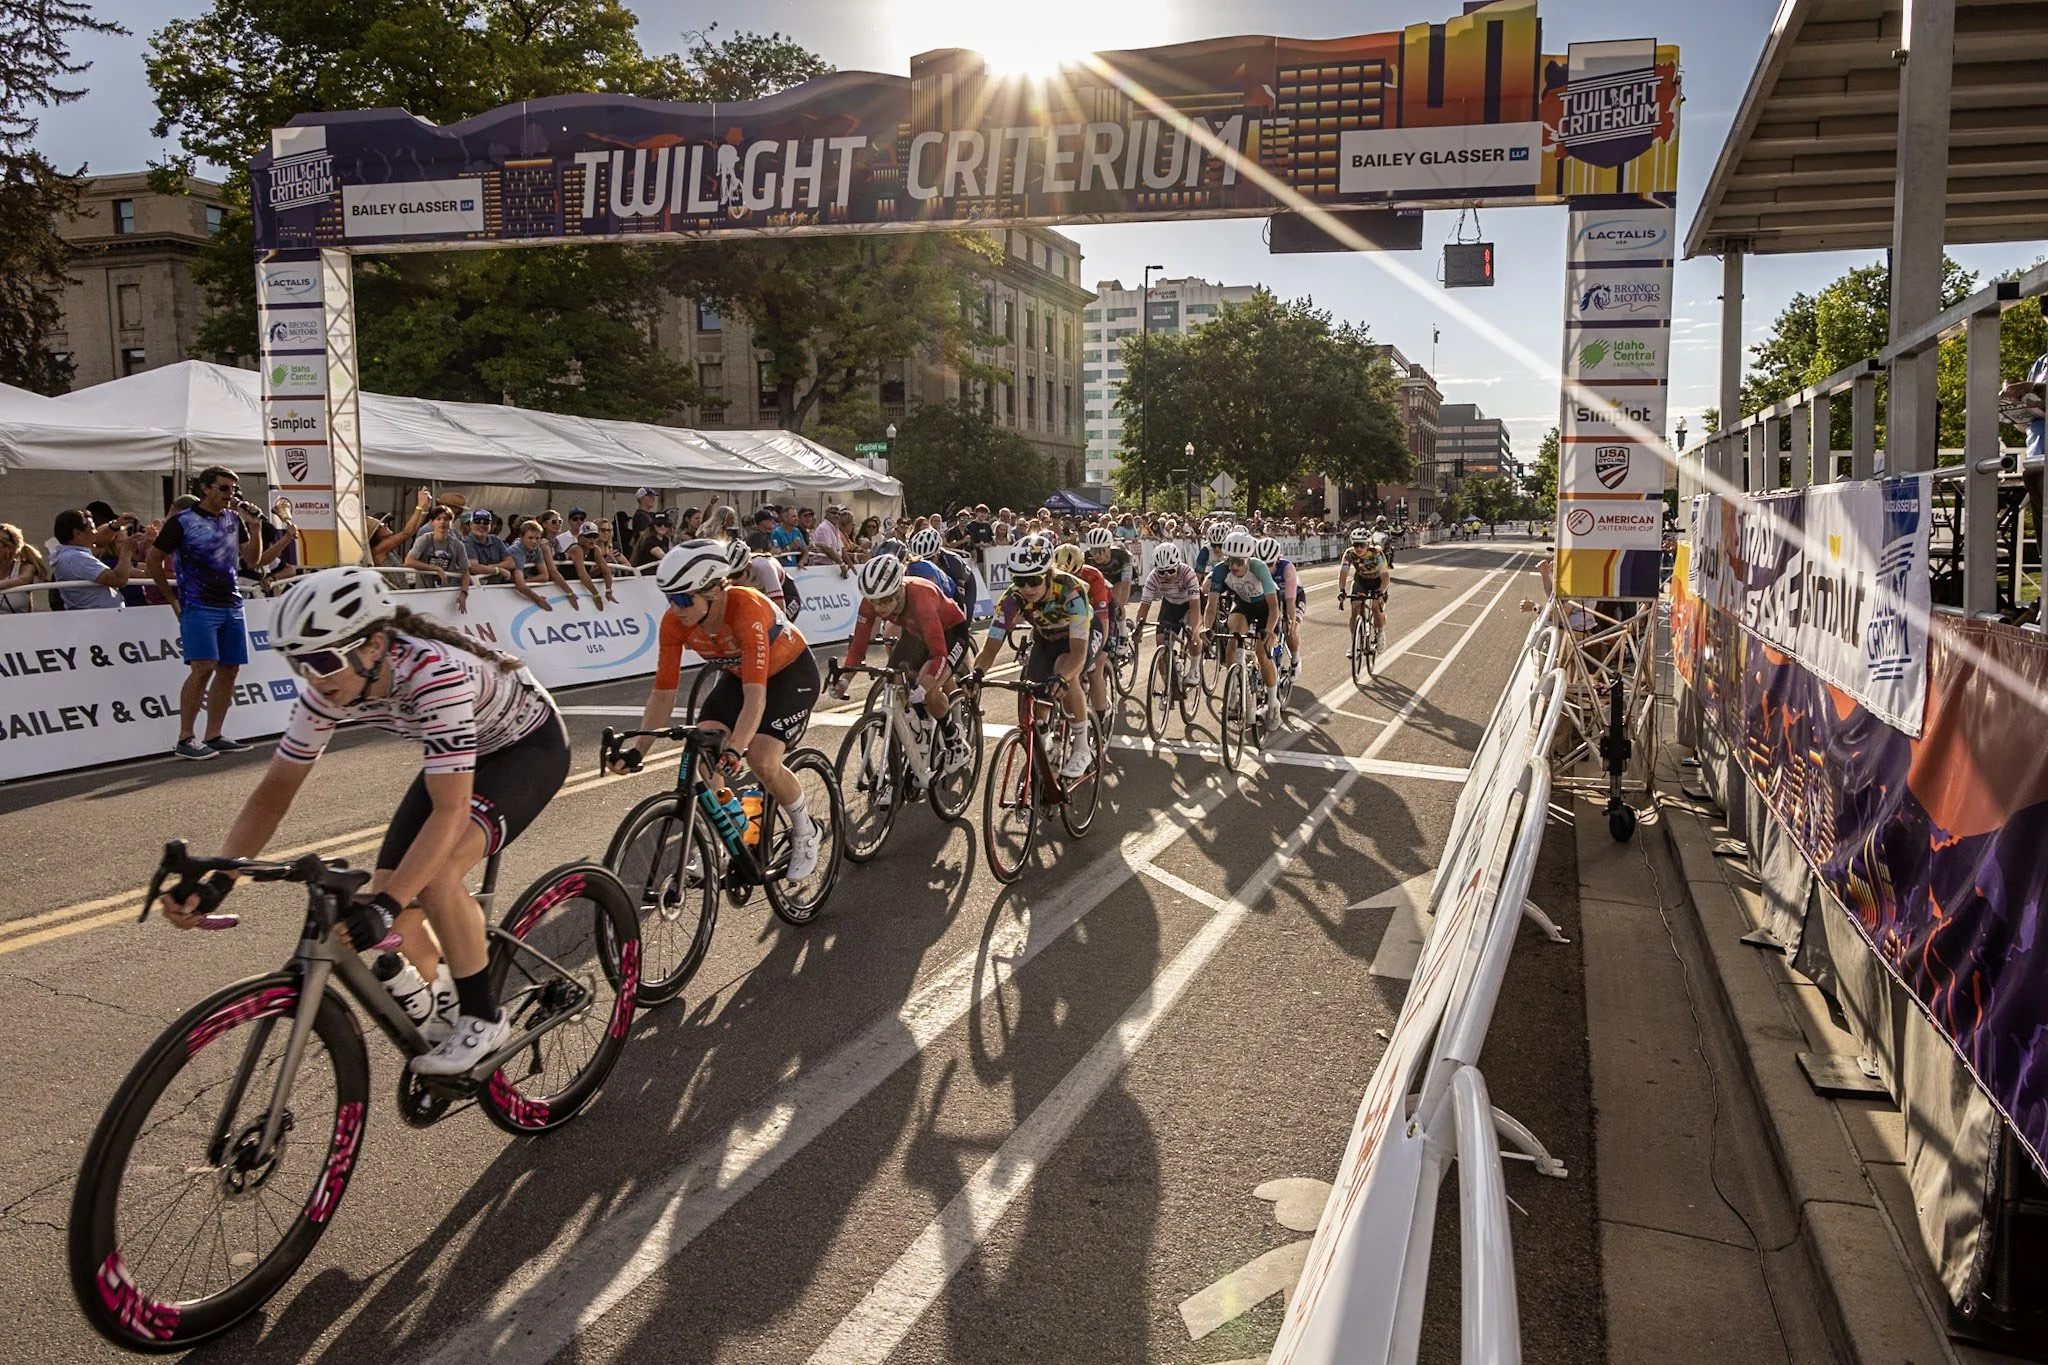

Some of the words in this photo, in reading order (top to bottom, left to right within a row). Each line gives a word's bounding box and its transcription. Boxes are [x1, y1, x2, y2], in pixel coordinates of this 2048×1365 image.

[1558, 102, 1660, 138] CRITERIUM
[906, 114, 1243, 200] CRITERIUM
[1351, 152, 1416, 168] BAILEY
[1419, 148, 1505, 165] GLASSER
[1510, 149, 1528, 159] LLP
[269, 178, 335, 204] CRITERIUM
[352, 203, 396, 217] BAILEY
[399, 200, 458, 214] GLASSER
[461, 201, 474, 210] LLP
[1588, 229, 1656, 240] LACTALIS
[268, 278, 311, 287] LACTALIS
[1614, 284, 1660, 293] BRONCO
[1614, 293, 1660, 303] MOTORS
[289, 320, 317, 328] BRONCO
[1613, 340, 1645, 350] Idaho
[1613, 350, 1656, 361] Central
[291, 373, 318, 381] Central
[1577, 406, 1651, 427] Simplot
[271, 417, 317, 433] Simplot
[1599, 449, 1626, 459] USA
[1597, 514, 1654, 524] AMERICAN
[800, 593, 851, 612] ACTALIS
[528, 617, 640, 645] LACTALIS
[586, 644, 605, 654] USA
[90, 645, 113, 667] &
[111, 701, 136, 724] &
[273, 685, 294, 697] LLP
